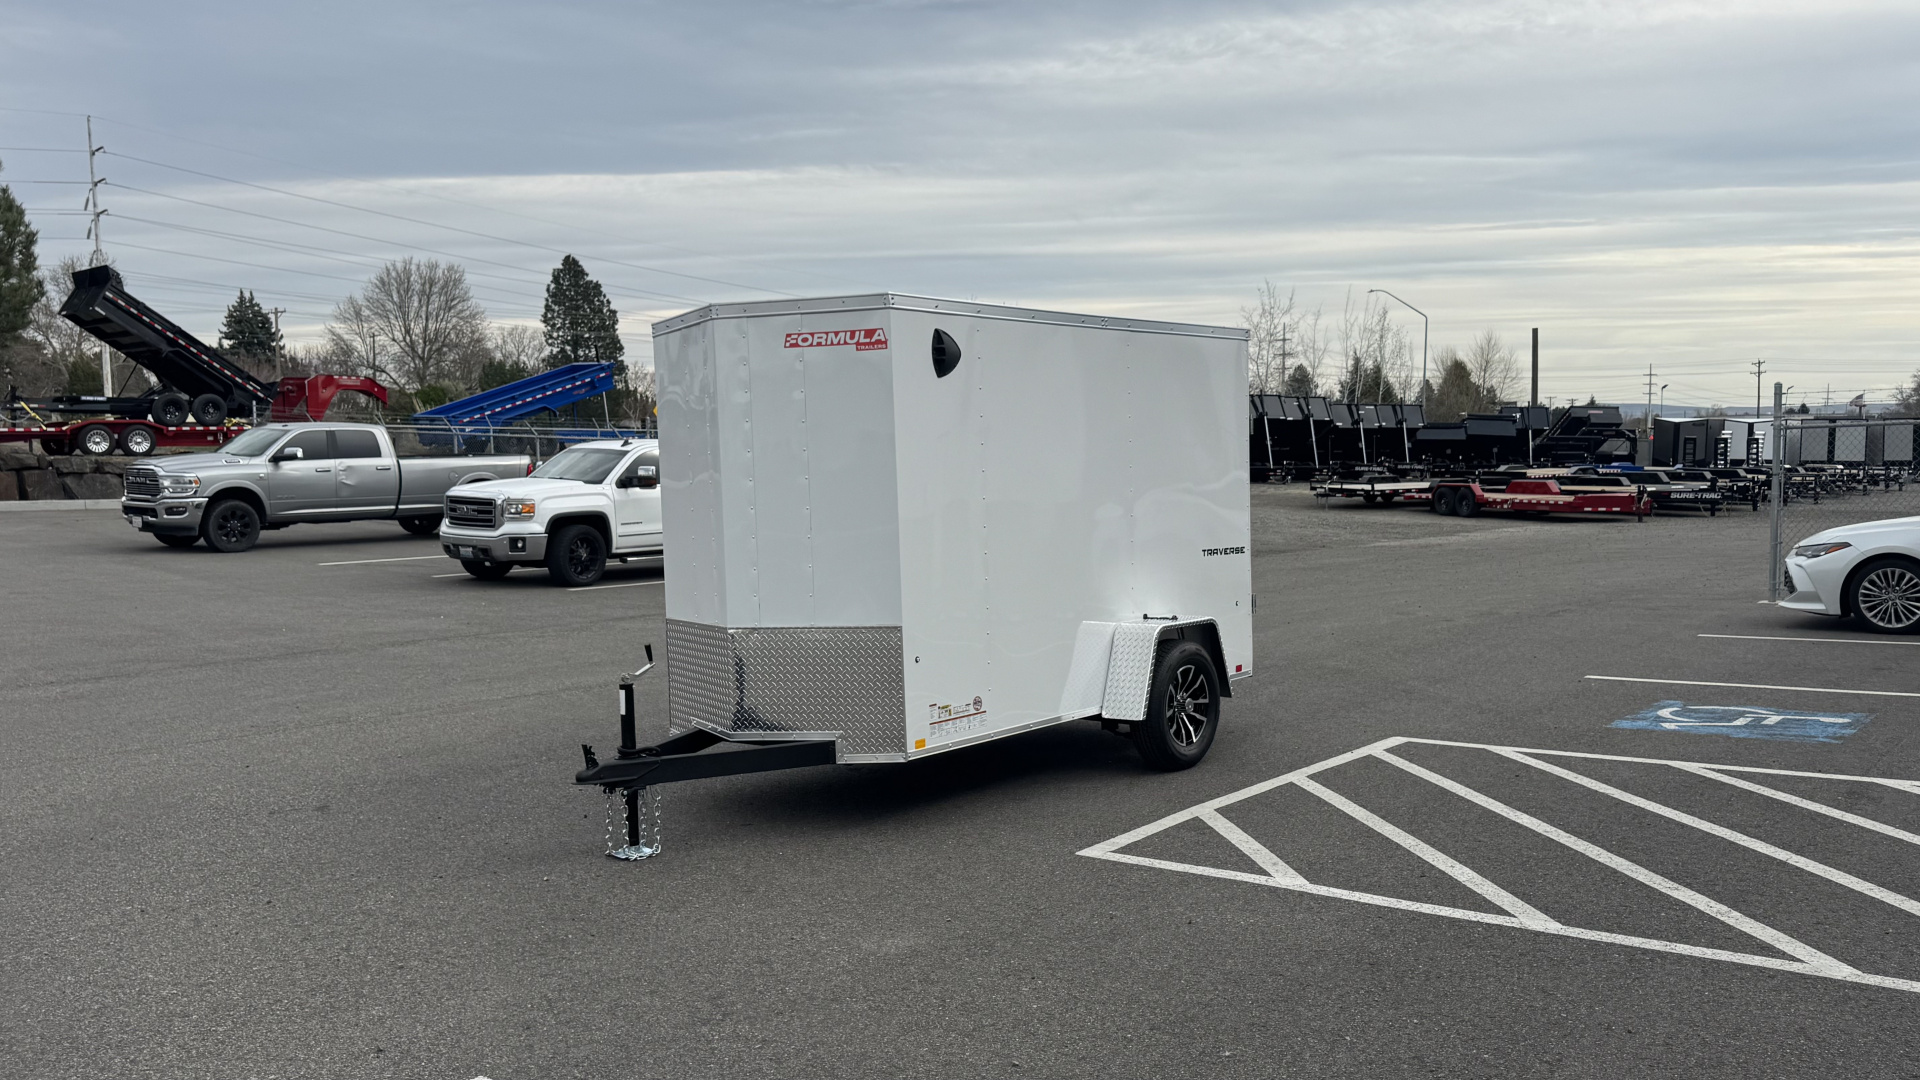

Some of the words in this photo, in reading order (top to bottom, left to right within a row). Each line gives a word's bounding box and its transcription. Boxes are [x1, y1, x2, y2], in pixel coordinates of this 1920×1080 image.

[785, 329, 886, 347] FORMULA
[1670, 491, 1722, 499] SURE-TRAC
[1201, 546, 1246, 557] TRAVERSE
